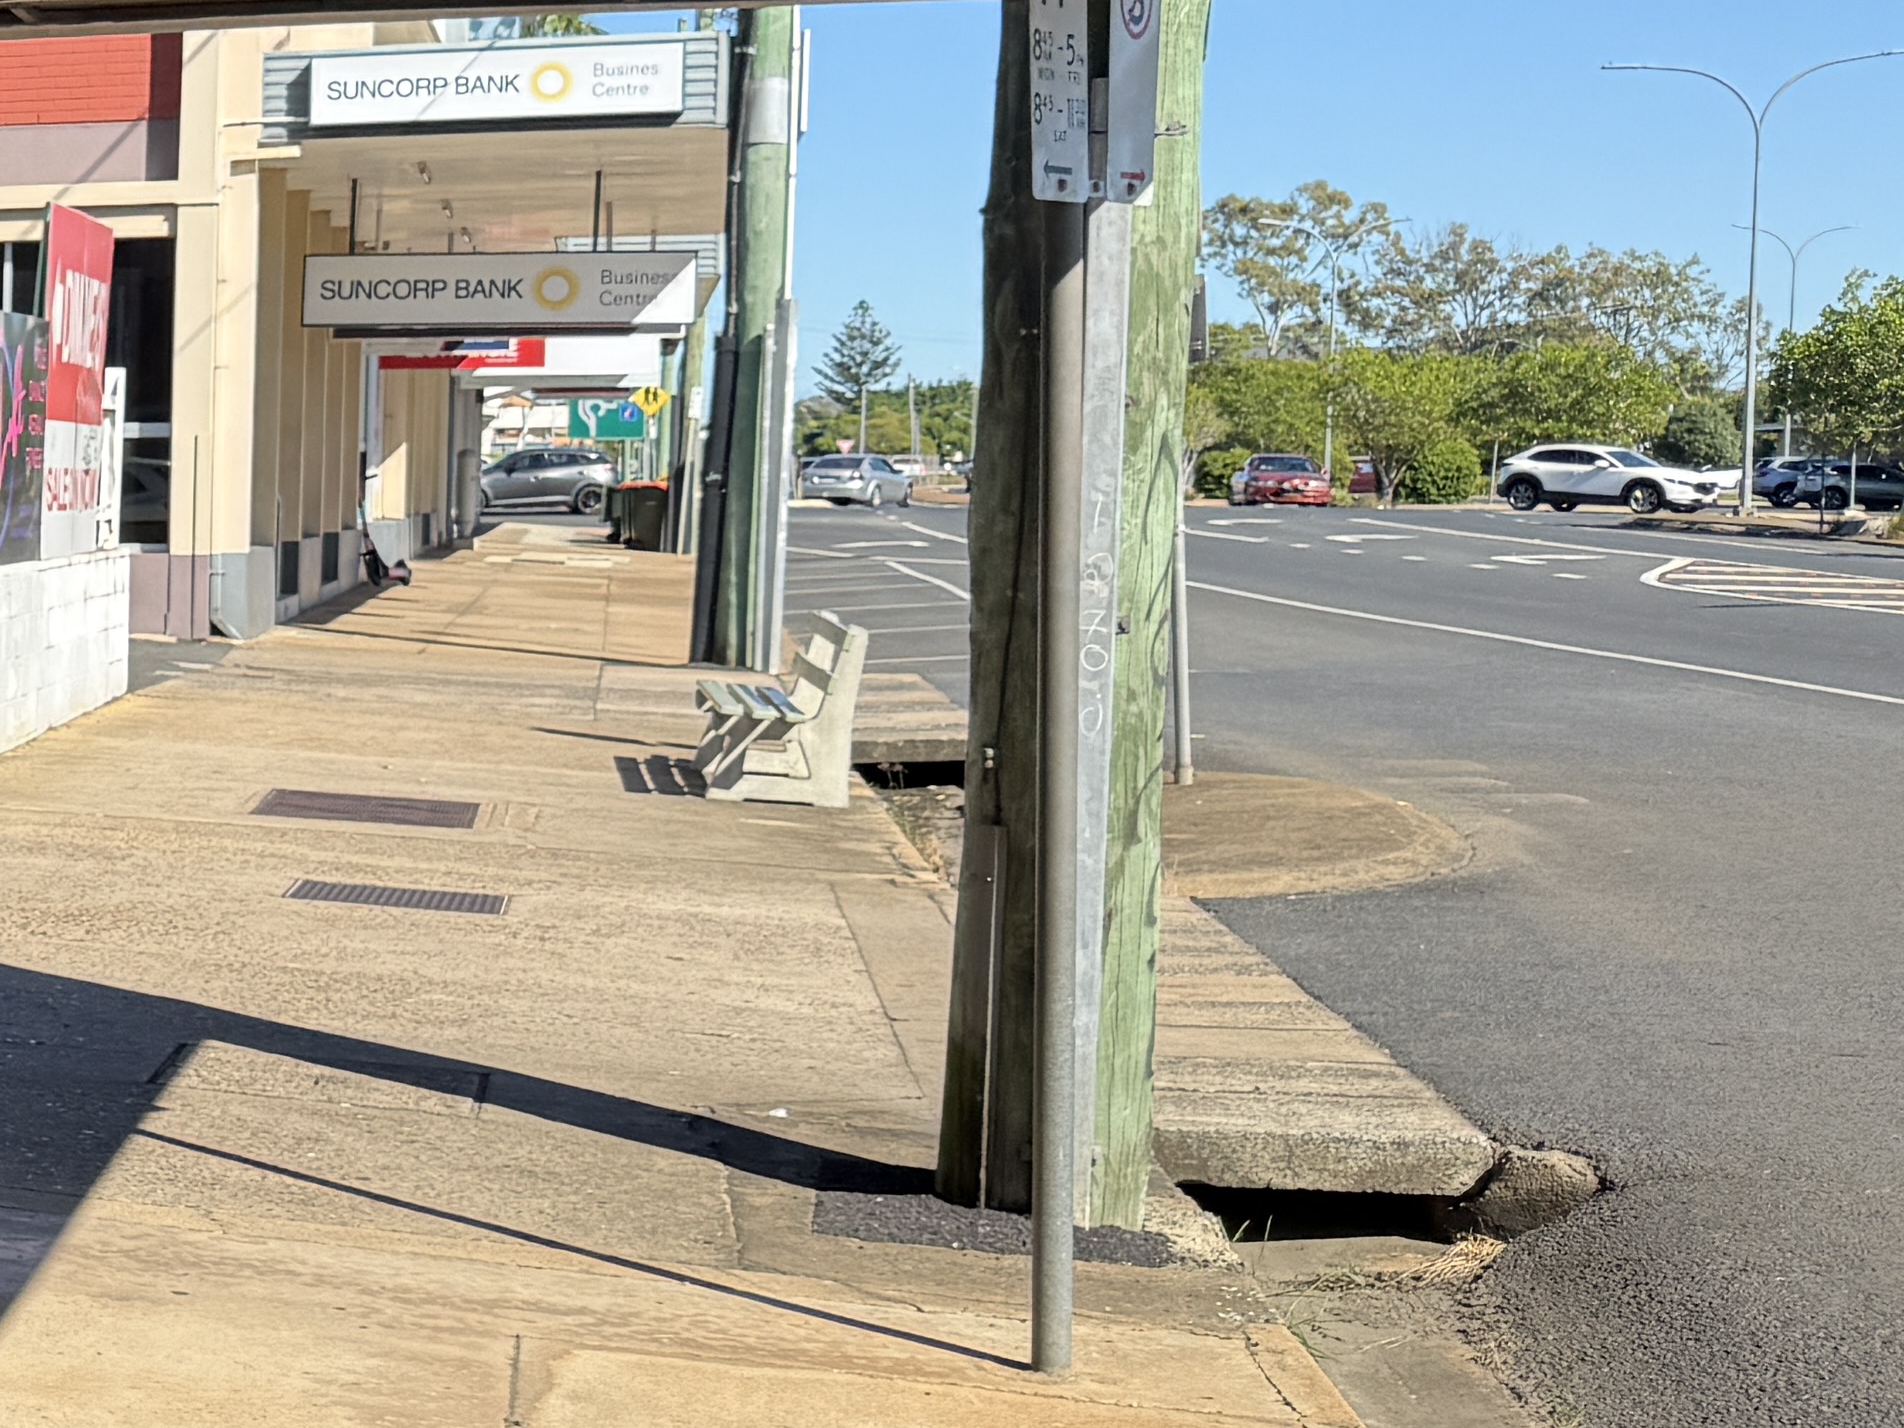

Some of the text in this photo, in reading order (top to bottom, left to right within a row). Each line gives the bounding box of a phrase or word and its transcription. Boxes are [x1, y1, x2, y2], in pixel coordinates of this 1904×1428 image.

[327, 73, 520, 101] SUNCORP BANK
[592, 82, 650, 98] Centre
[320, 277, 524, 300] SUNCORP BANK
